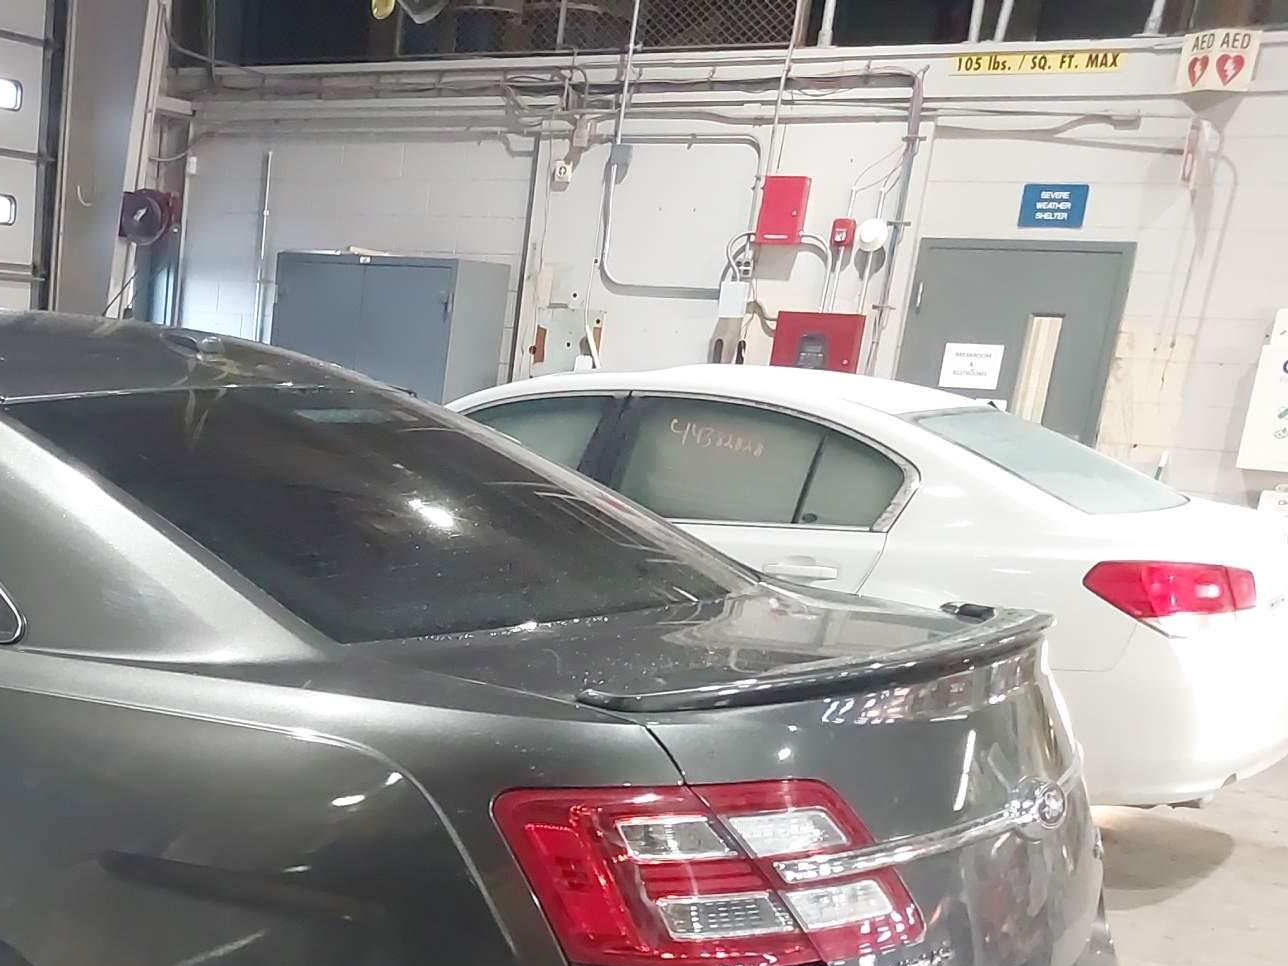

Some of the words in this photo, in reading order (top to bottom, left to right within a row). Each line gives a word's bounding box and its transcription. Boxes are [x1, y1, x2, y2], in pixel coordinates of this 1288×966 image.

[1192, 33, 1216, 52] AED
[1220, 32, 1252, 50] AED
[957, 56, 983, 72] 105
[987, 55, 1012, 71] lbs.
[1018, 55, 1026, 70] /
[1030, 55, 1052, 70] SQ.
[1059, 54, 1079, 70] FT.
[1085, 52, 1121, 69] MAX
[1040, 191, 1071, 199] SEVERE
[1035, 201, 1072, 210] WEATHER
[1034, 212, 1068, 220] SHELTER
